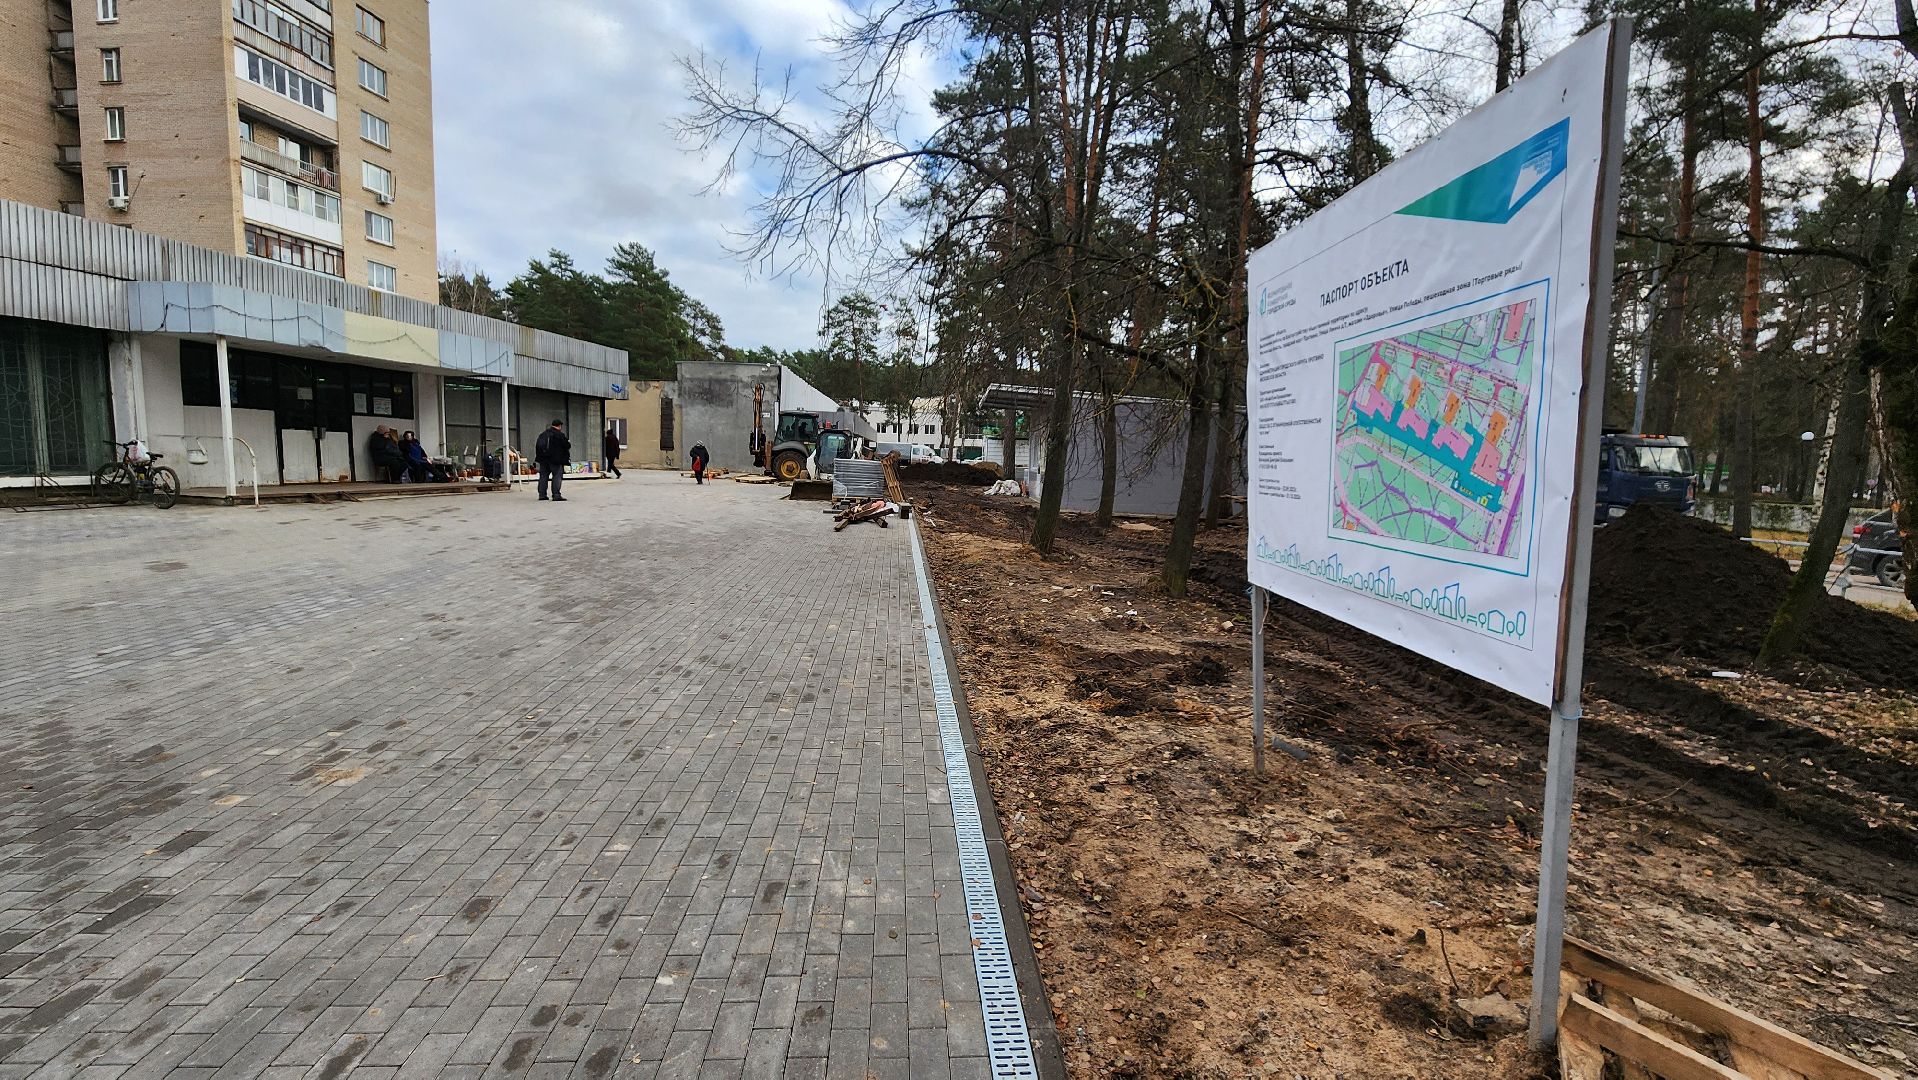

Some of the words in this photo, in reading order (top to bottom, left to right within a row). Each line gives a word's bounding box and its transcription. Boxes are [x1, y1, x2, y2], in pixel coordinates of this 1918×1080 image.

[1319, 279, 1359, 308] ПАСПОРТ
[1360, 258, 1409, 291] ОБЪЕКТА
[1423, 286, 1456, 302] пешеходная
[1456, 281, 1471, 292] зона
